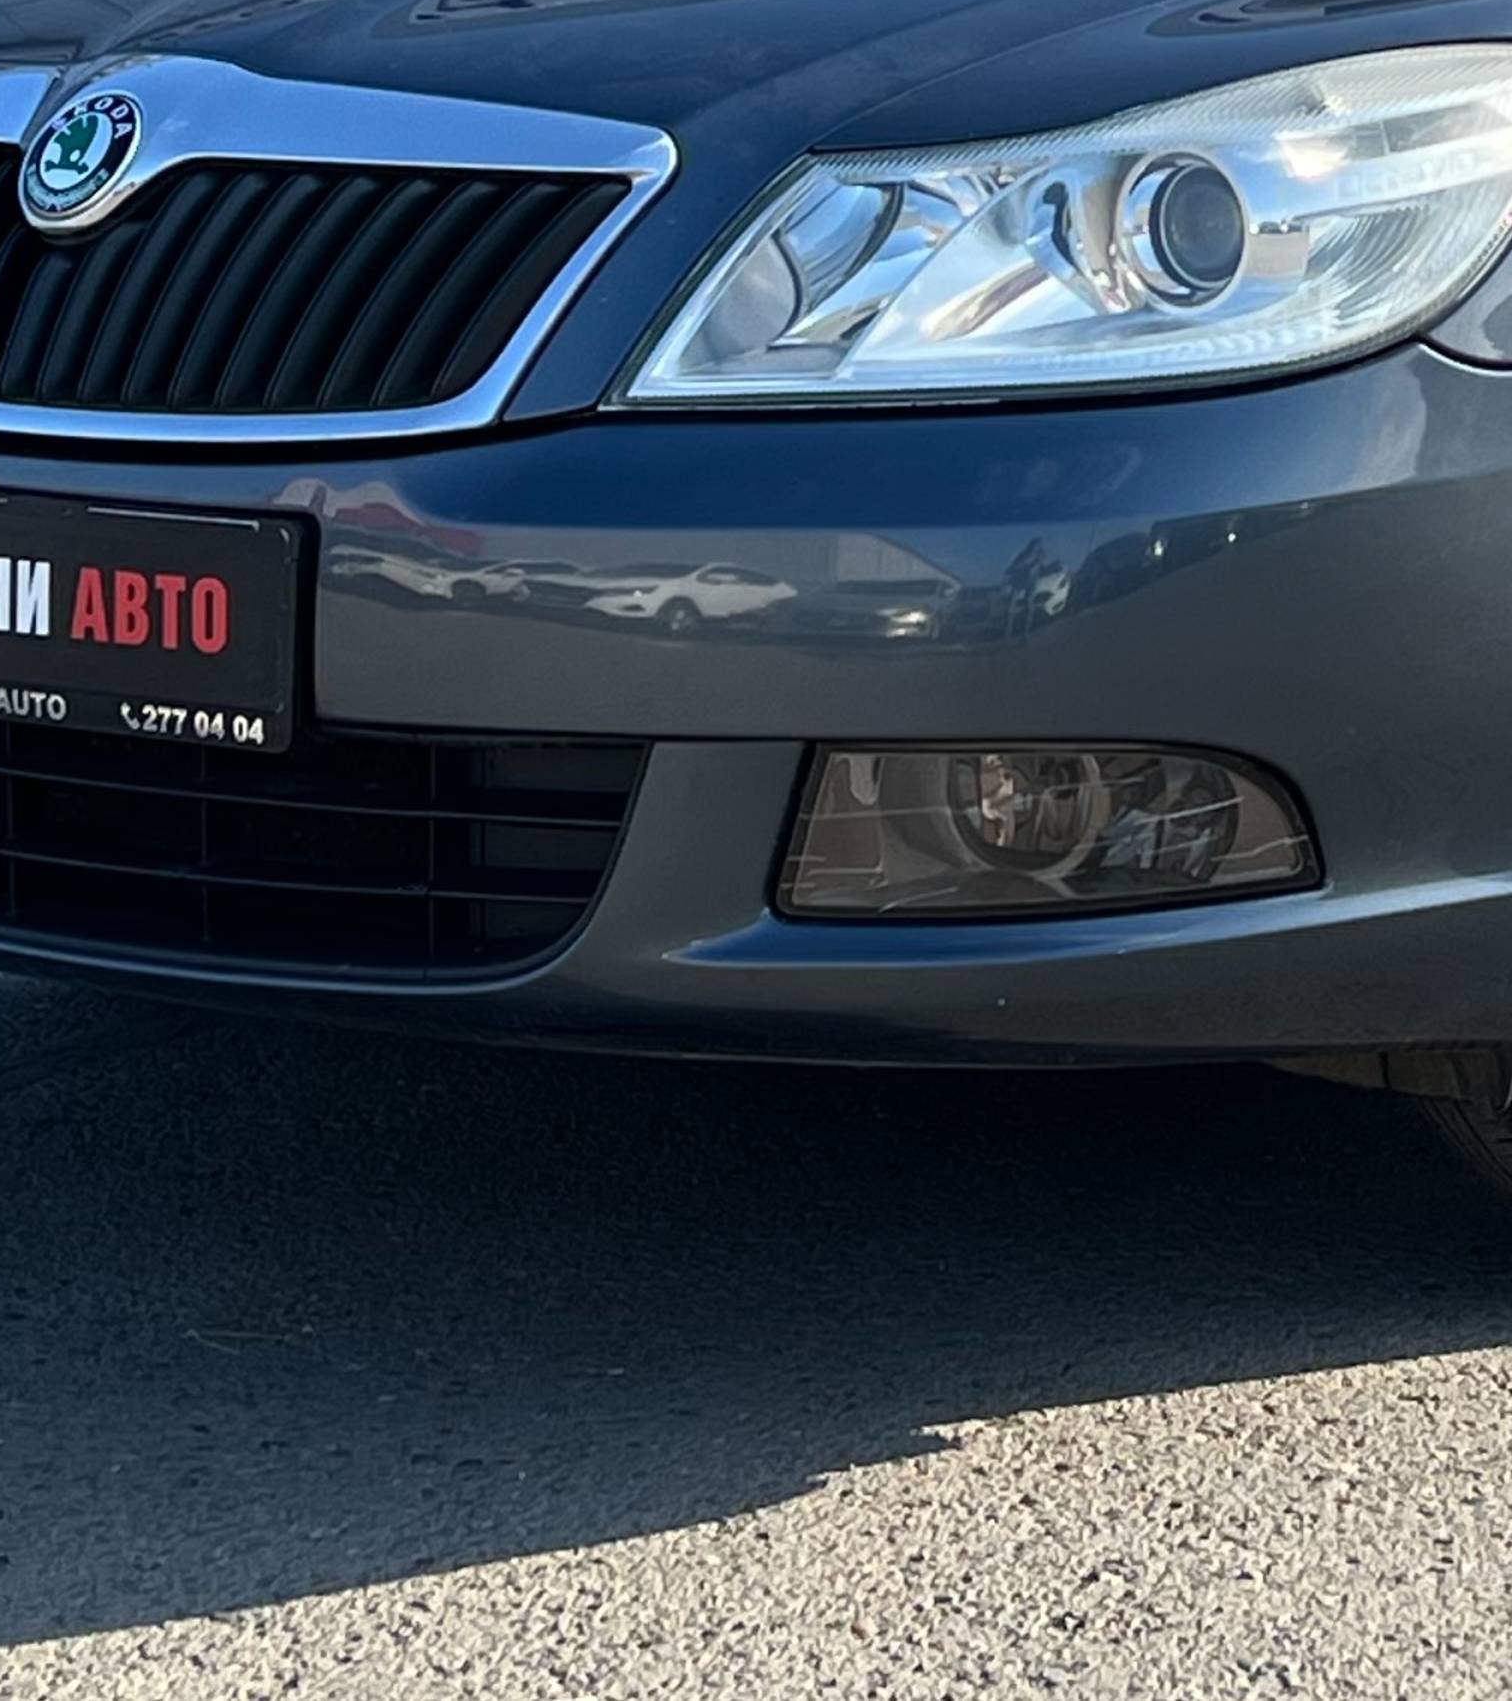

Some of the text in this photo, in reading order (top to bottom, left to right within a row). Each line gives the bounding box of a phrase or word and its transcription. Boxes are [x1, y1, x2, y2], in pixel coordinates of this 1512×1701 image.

[70, 565, 229, 656] АВТО
[141, 704, 265, 747] 277 04 04
